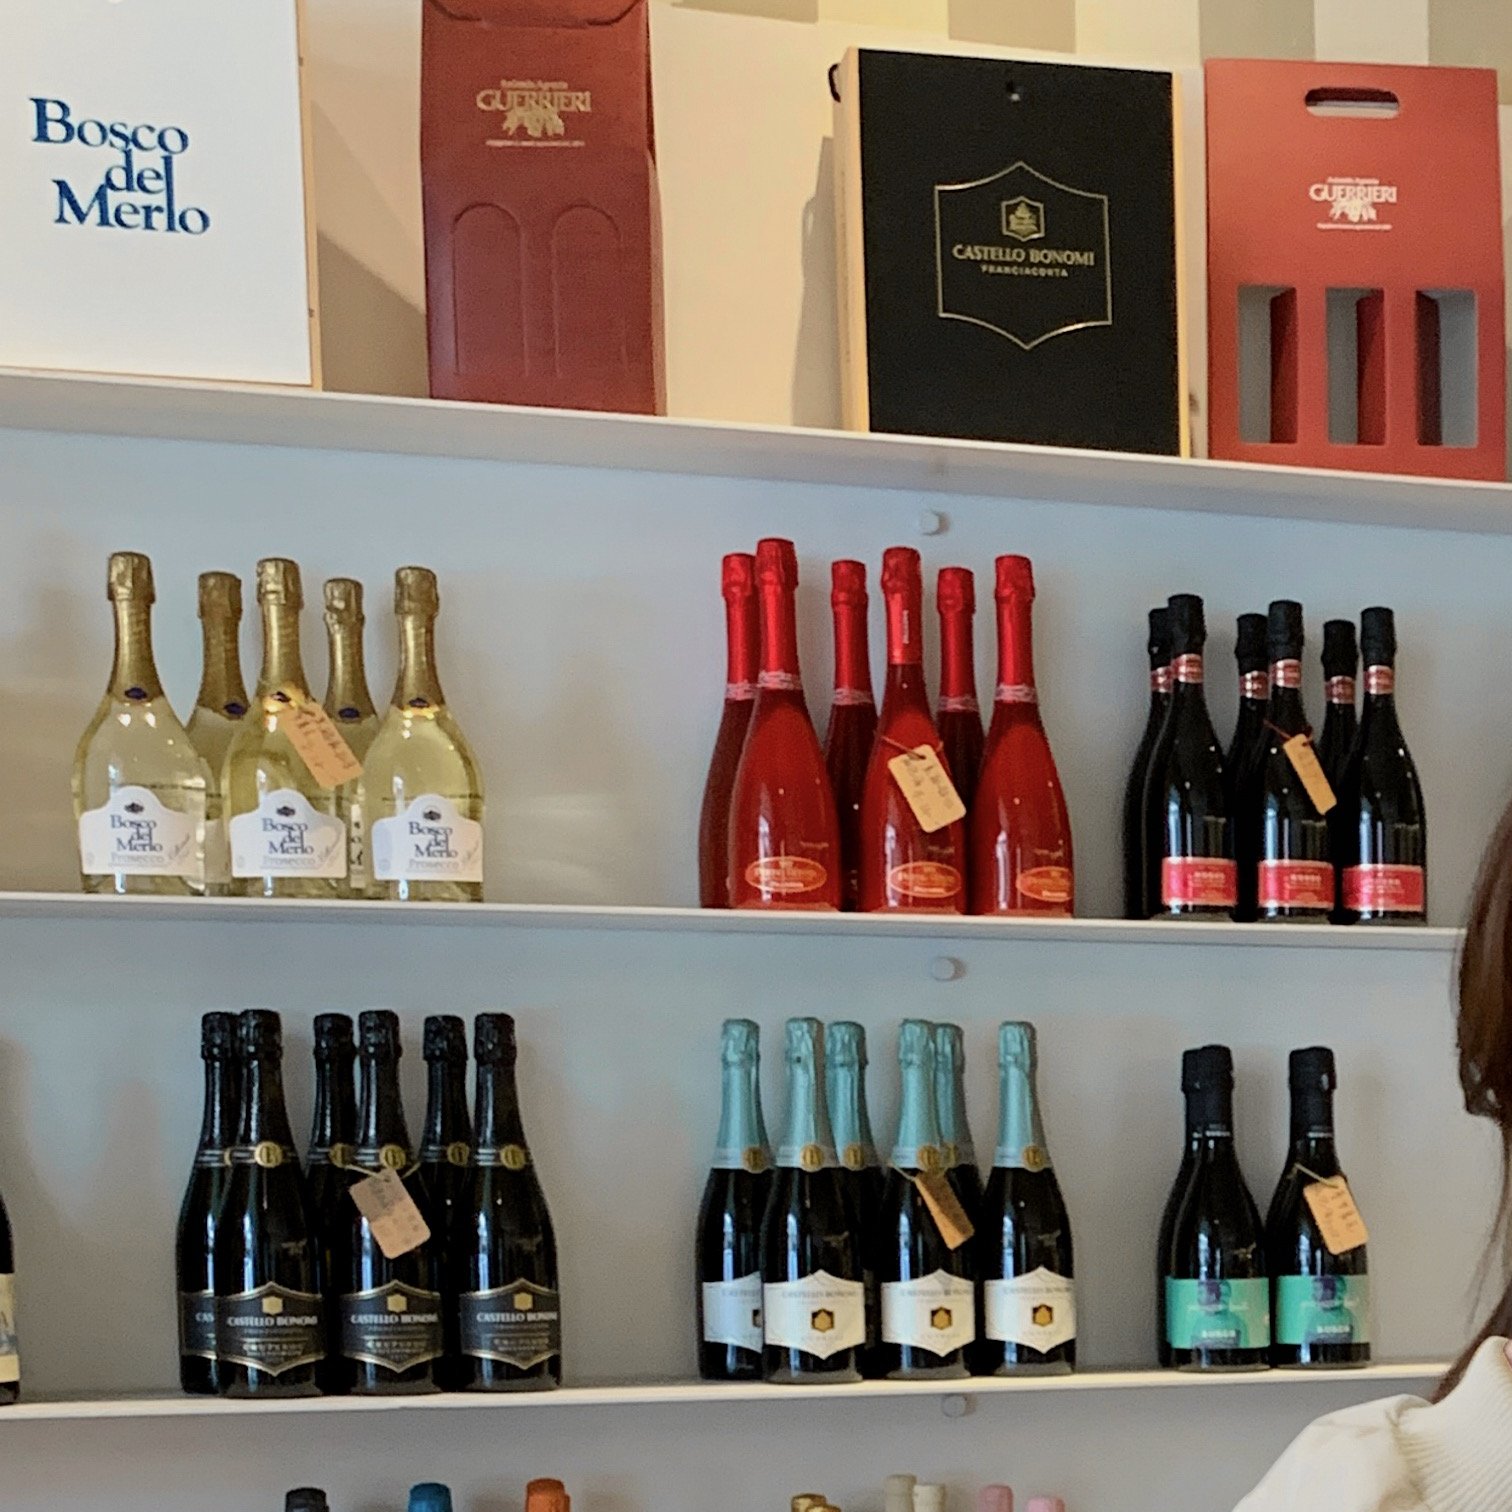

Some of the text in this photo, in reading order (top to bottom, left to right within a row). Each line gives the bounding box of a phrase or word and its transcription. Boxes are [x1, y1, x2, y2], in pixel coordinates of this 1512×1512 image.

[476, 89, 591, 112] GUERRIERI
[29, 97, 189, 155] Bosco
[104, 148, 174, 195] del
[1309, 184, 1397, 203] GUERRIERI
[52, 178, 210, 235] Merlo
[952, 244, 1095, 266] CASTELLO BONOMI
[980, 264, 1068, 277] FRANCIACORTA
[110, 815, 157, 829] Bosco
[262, 818, 308, 831] Bosco
[409, 821, 453, 835] Bosco
[117, 838, 163, 852] Merlo
[268, 841, 314, 854] Merlo
[414, 843, 458, 857] Merlo
